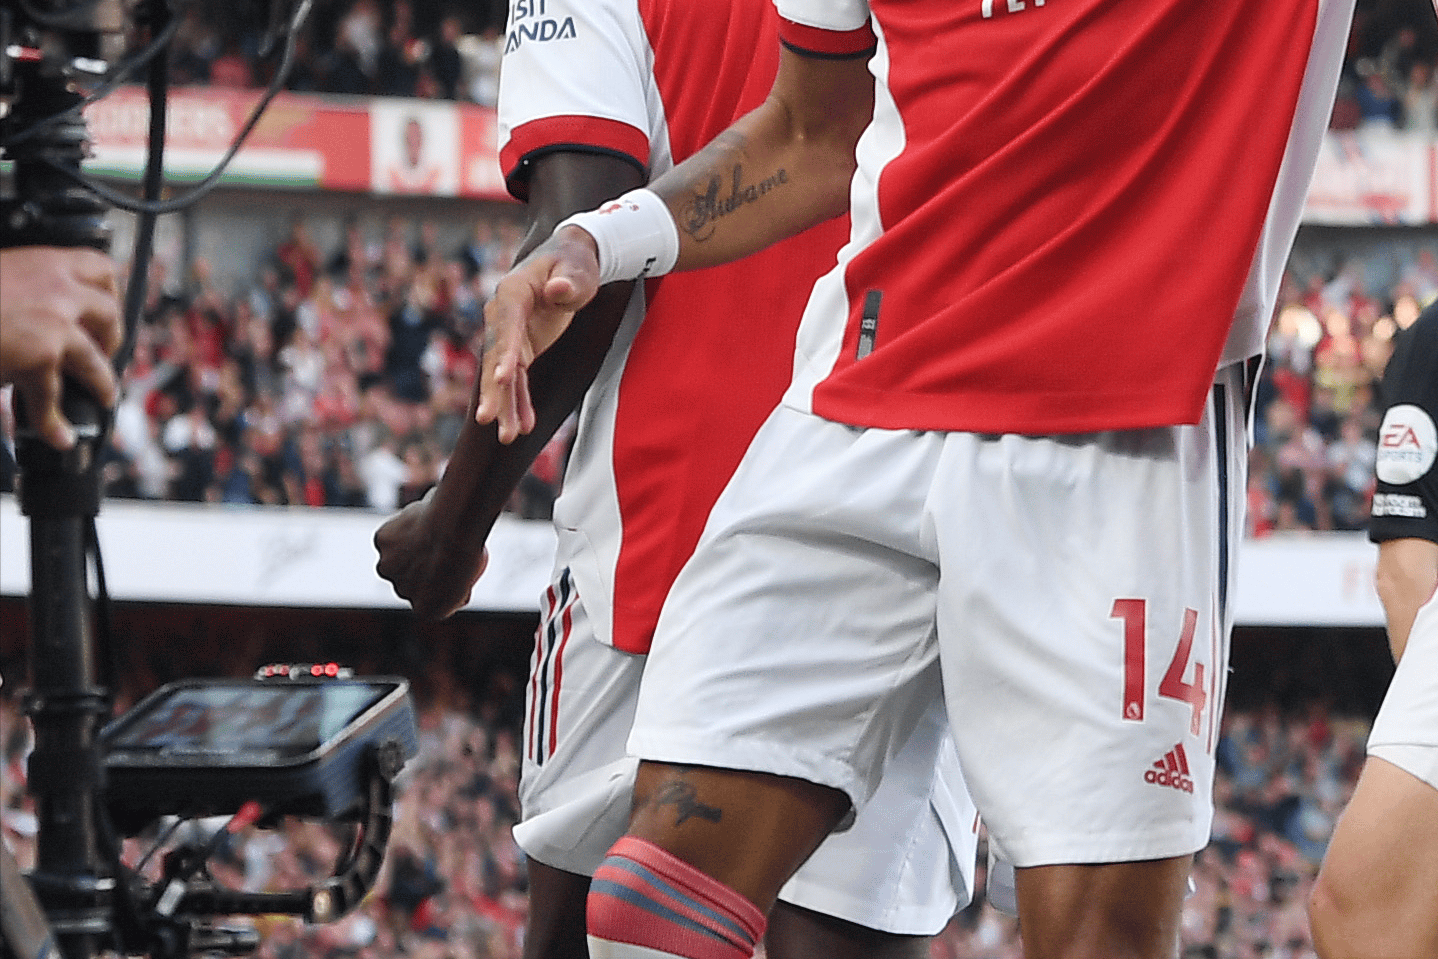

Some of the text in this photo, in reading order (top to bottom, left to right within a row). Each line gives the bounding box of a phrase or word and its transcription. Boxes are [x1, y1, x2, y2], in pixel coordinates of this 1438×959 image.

[504, 15, 578, 55] ANDA
[1383, 424, 1421, 450] EA
[1110, 597, 1207, 738] 14
